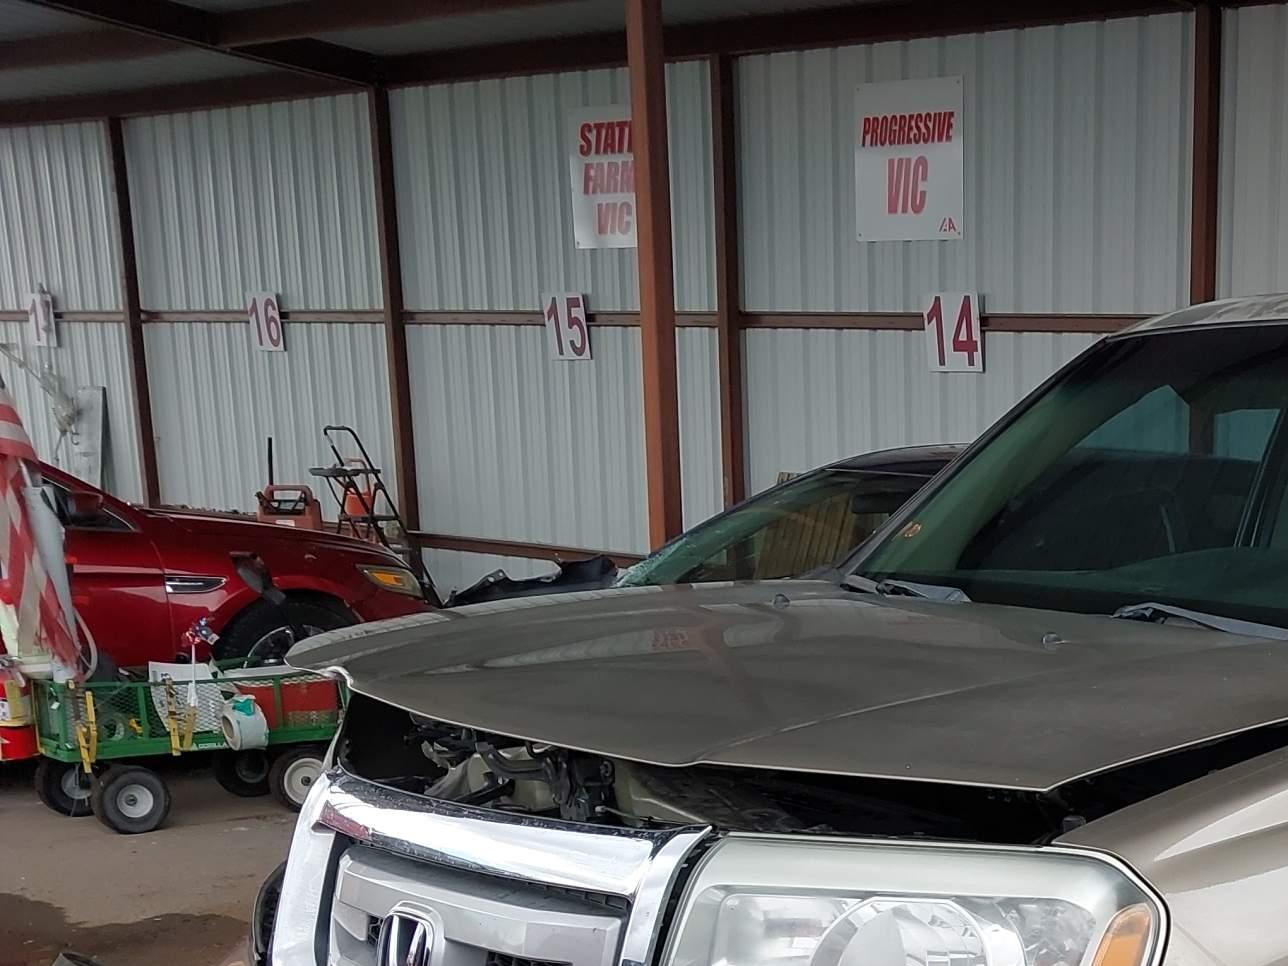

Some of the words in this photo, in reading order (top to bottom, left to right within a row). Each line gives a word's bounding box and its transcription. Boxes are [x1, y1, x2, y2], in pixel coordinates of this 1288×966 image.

[862, 111, 955, 148] PROGRESSIVE
[887, 155, 929, 215] VIC
[597, 201, 634, 236] VIC
[249, 296, 281, 348] 16
[546, 296, 587, 357] 15
[926, 295, 979, 367] 14
